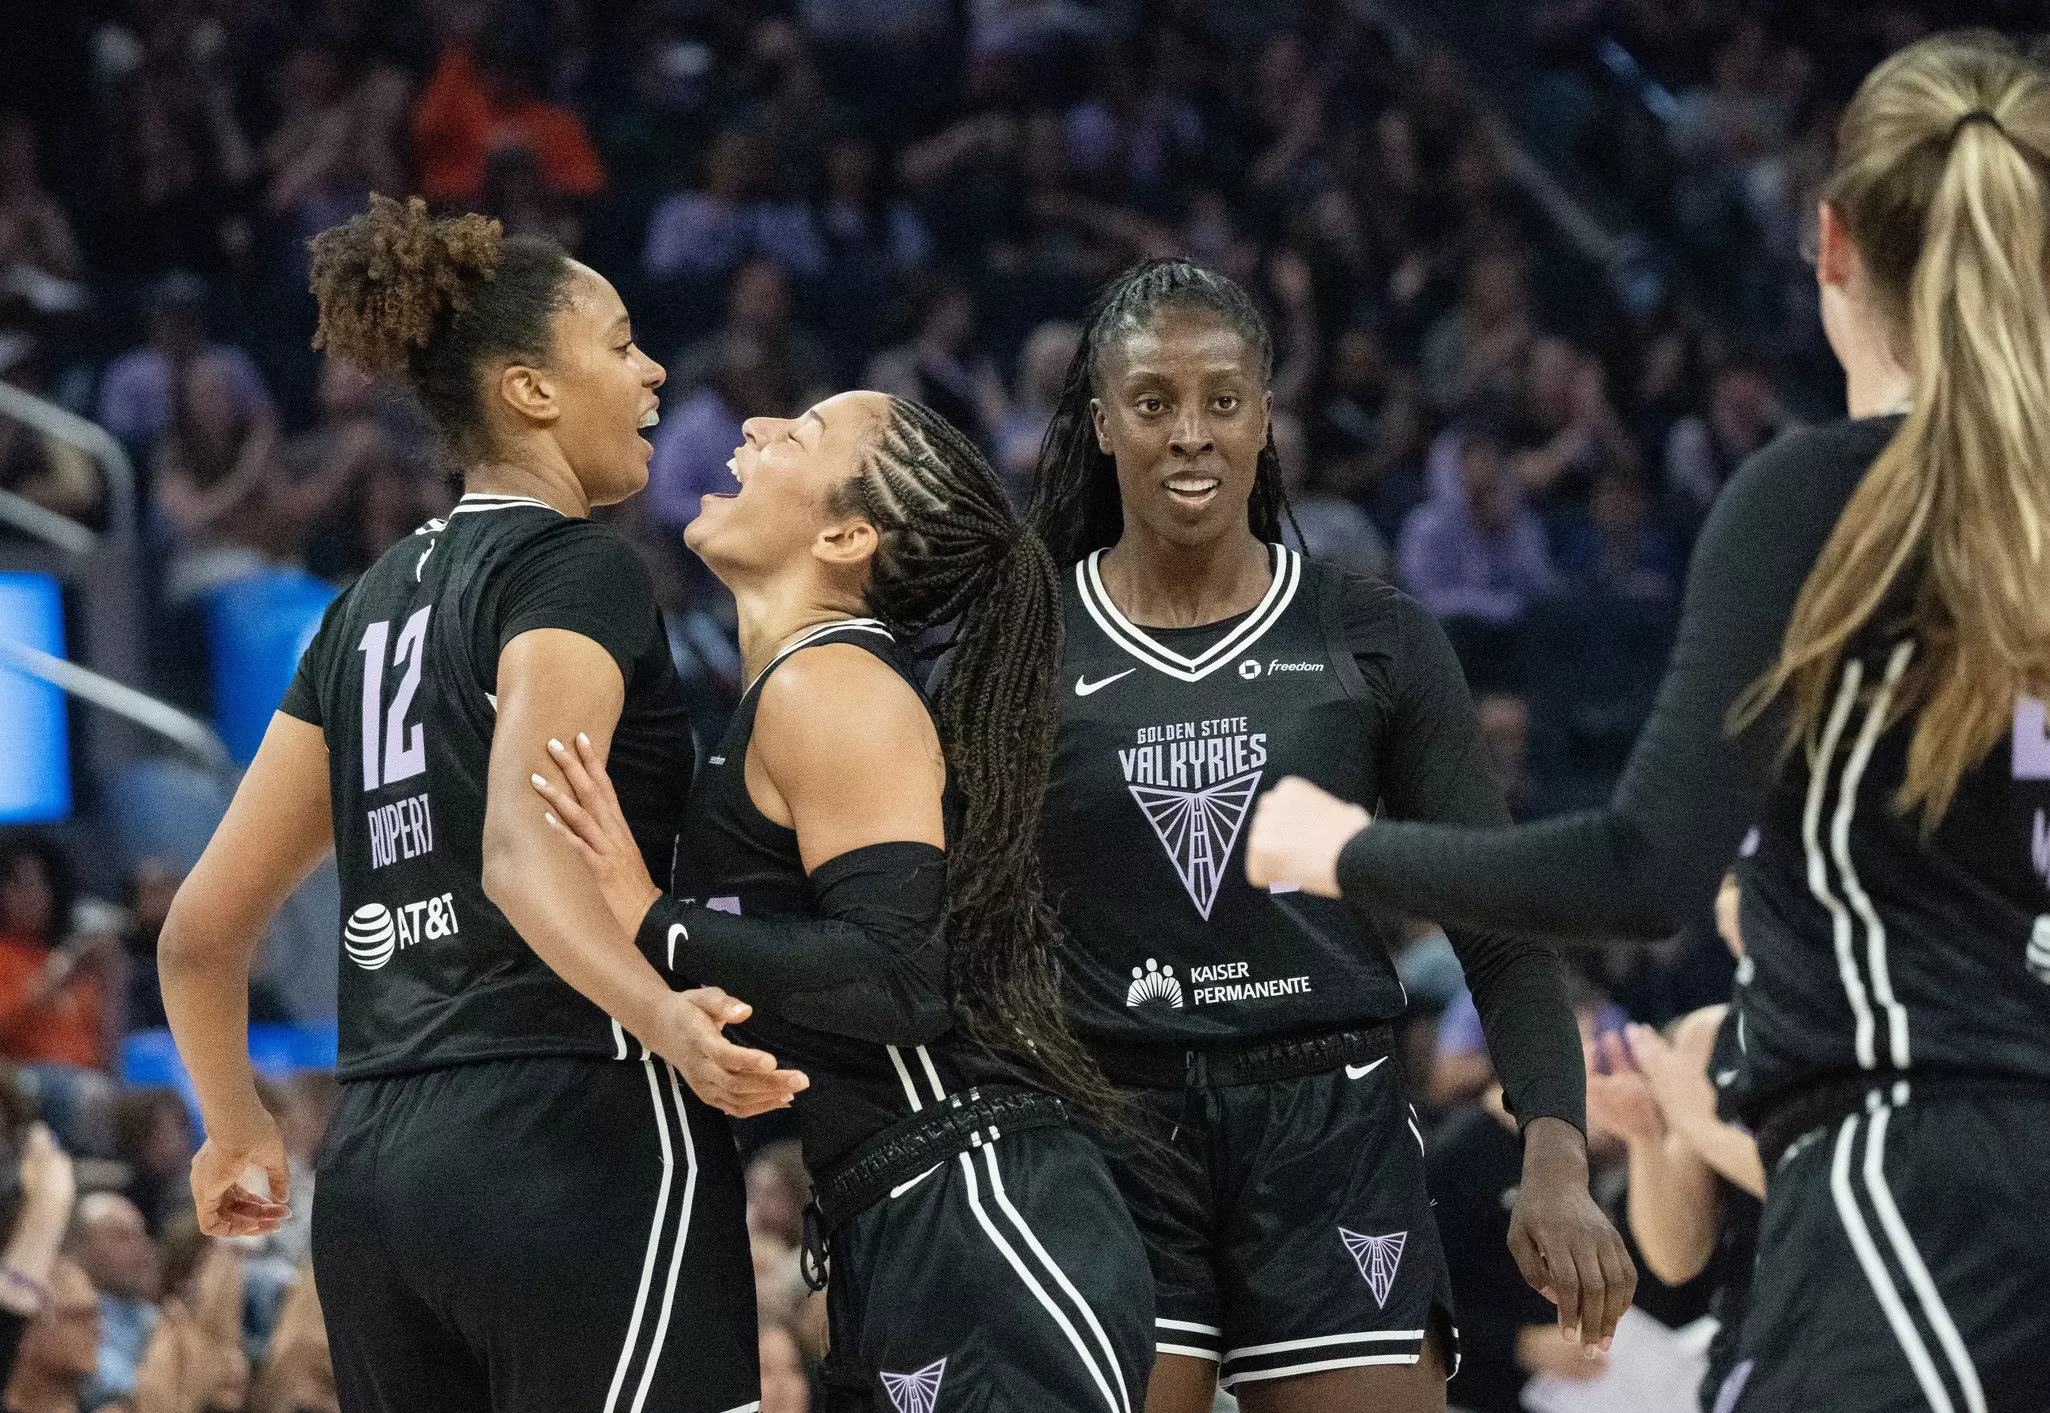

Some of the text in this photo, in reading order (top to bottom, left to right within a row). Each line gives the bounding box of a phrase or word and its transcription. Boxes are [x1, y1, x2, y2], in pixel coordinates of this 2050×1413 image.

[1268, 660, 1324, 675] freedom
[358, 605, 432, 792] 12
[1137, 717, 1248, 744] GOLDEN STATE
[1118, 734, 1267, 788] VALKYRIES
[368, 794, 433, 869] RUPERT
[397, 893, 459, 949] AT&T
[1191, 962, 1250, 983] KAISER
[1194, 976, 1312, 1005] PERMANENTE
